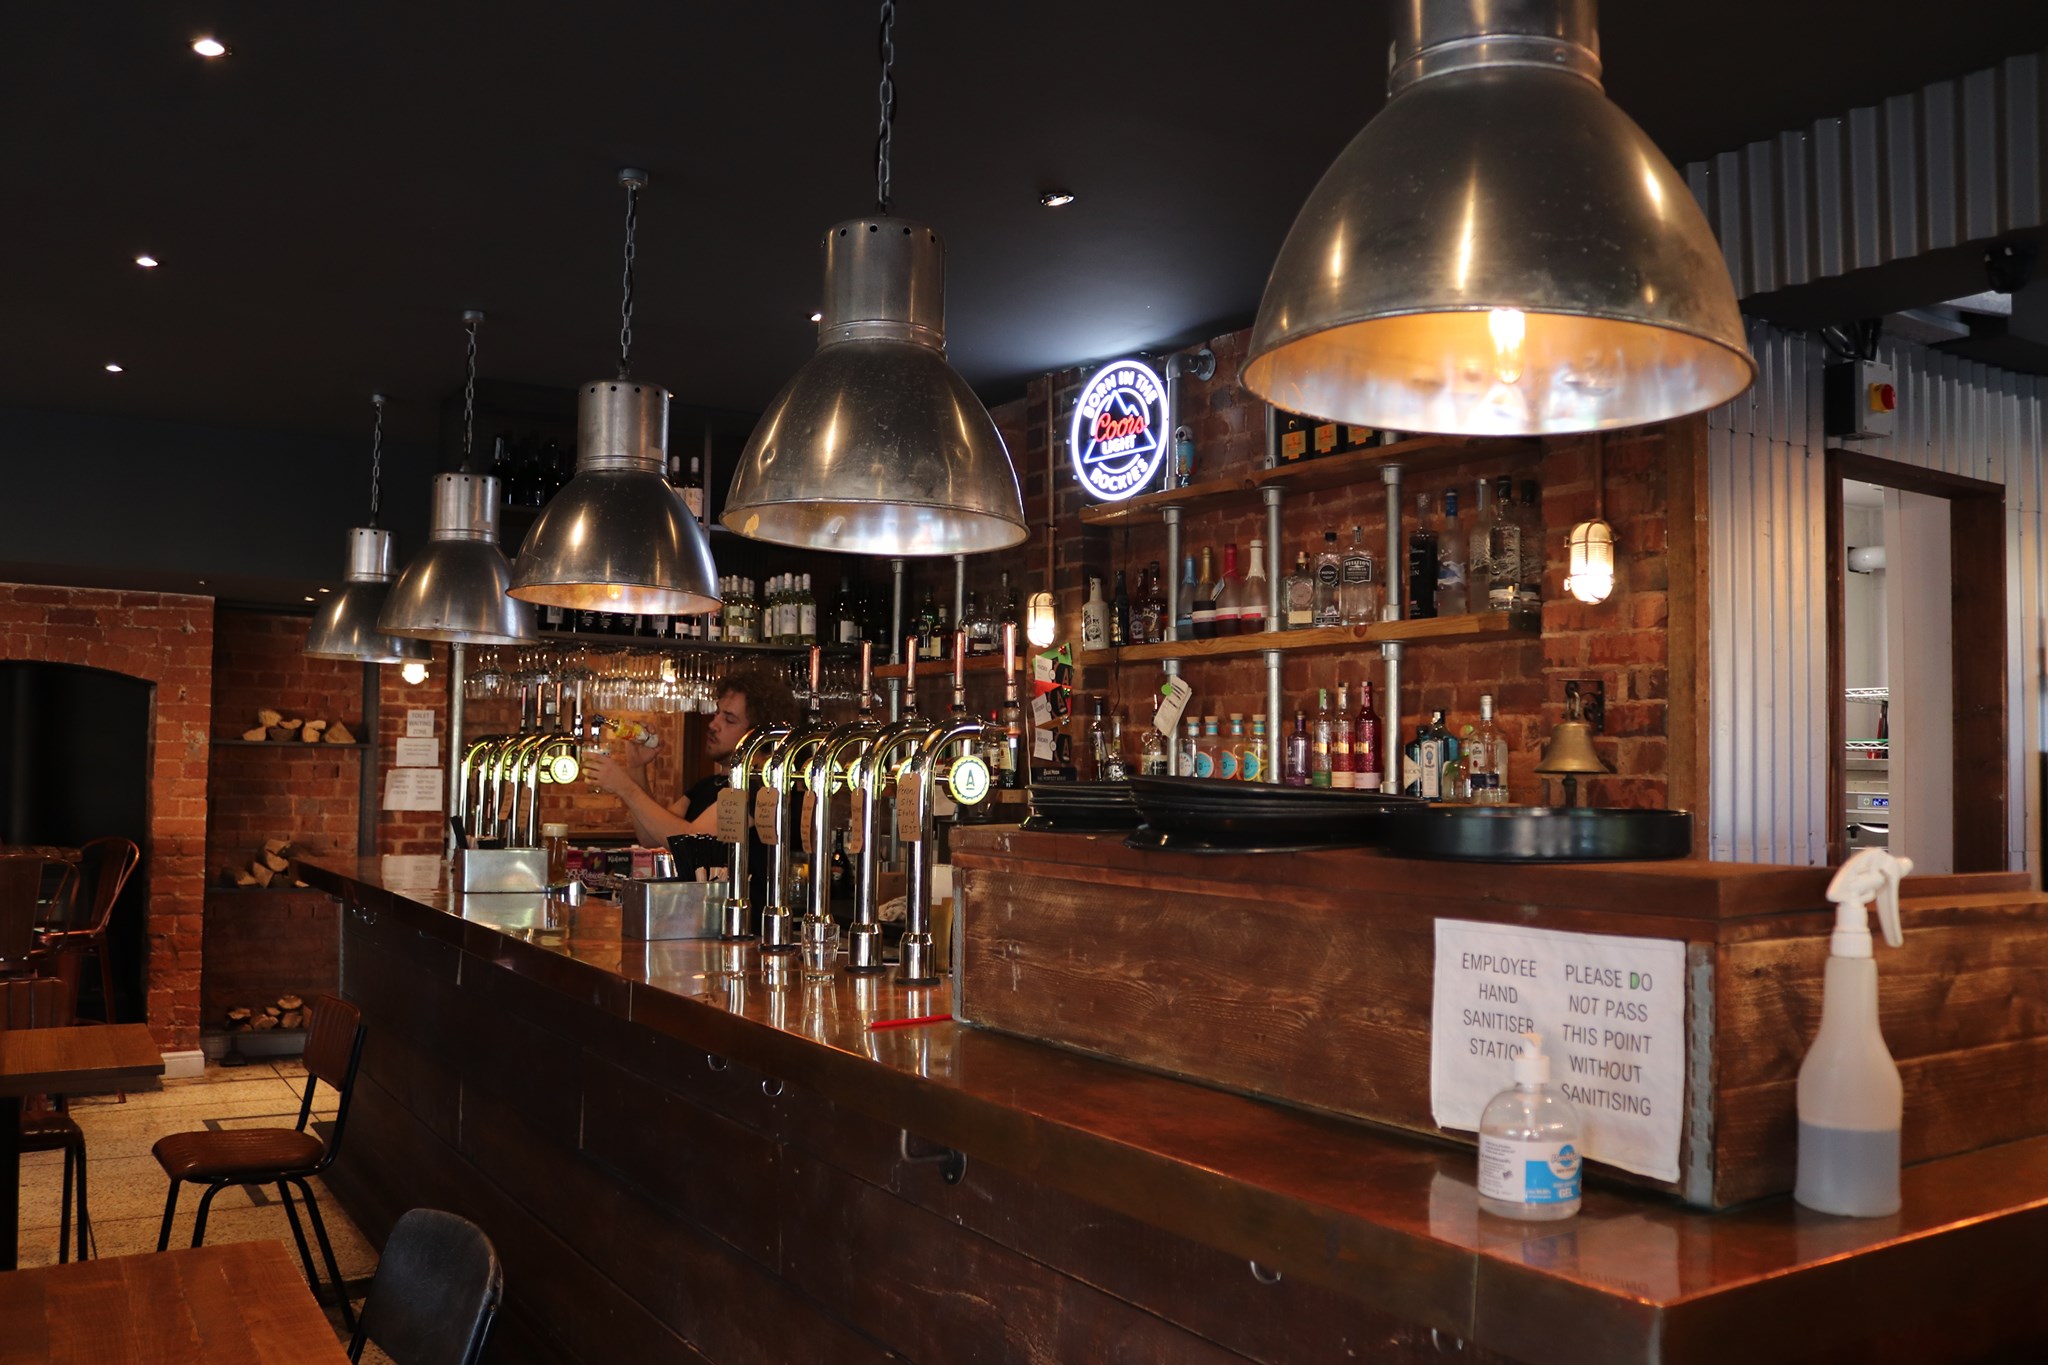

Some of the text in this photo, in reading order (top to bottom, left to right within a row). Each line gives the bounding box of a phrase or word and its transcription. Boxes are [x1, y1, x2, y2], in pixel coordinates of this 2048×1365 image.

[1083, 371, 1158, 419] BORN IN THE
[1094, 412, 1149, 442] Coors
[1101, 434, 1137, 455] LIGHT
[1089, 457, 1149, 491] ROCKIES
[1462, 952, 1537, 978] EMPLOYEE
[1565, 964, 1653, 992] PLEASE DO
[1479, 983, 1518, 1004] HAND
[1463, 1009, 1535, 1034] SANITISER
[1569, 995, 1648, 1023] NOT PASS
[1562, 1024, 1653, 1054] THIS POINT
[1569, 1055, 1642, 1084] WITHOUT
[1561, 1083, 1652, 1117] SANITISING
